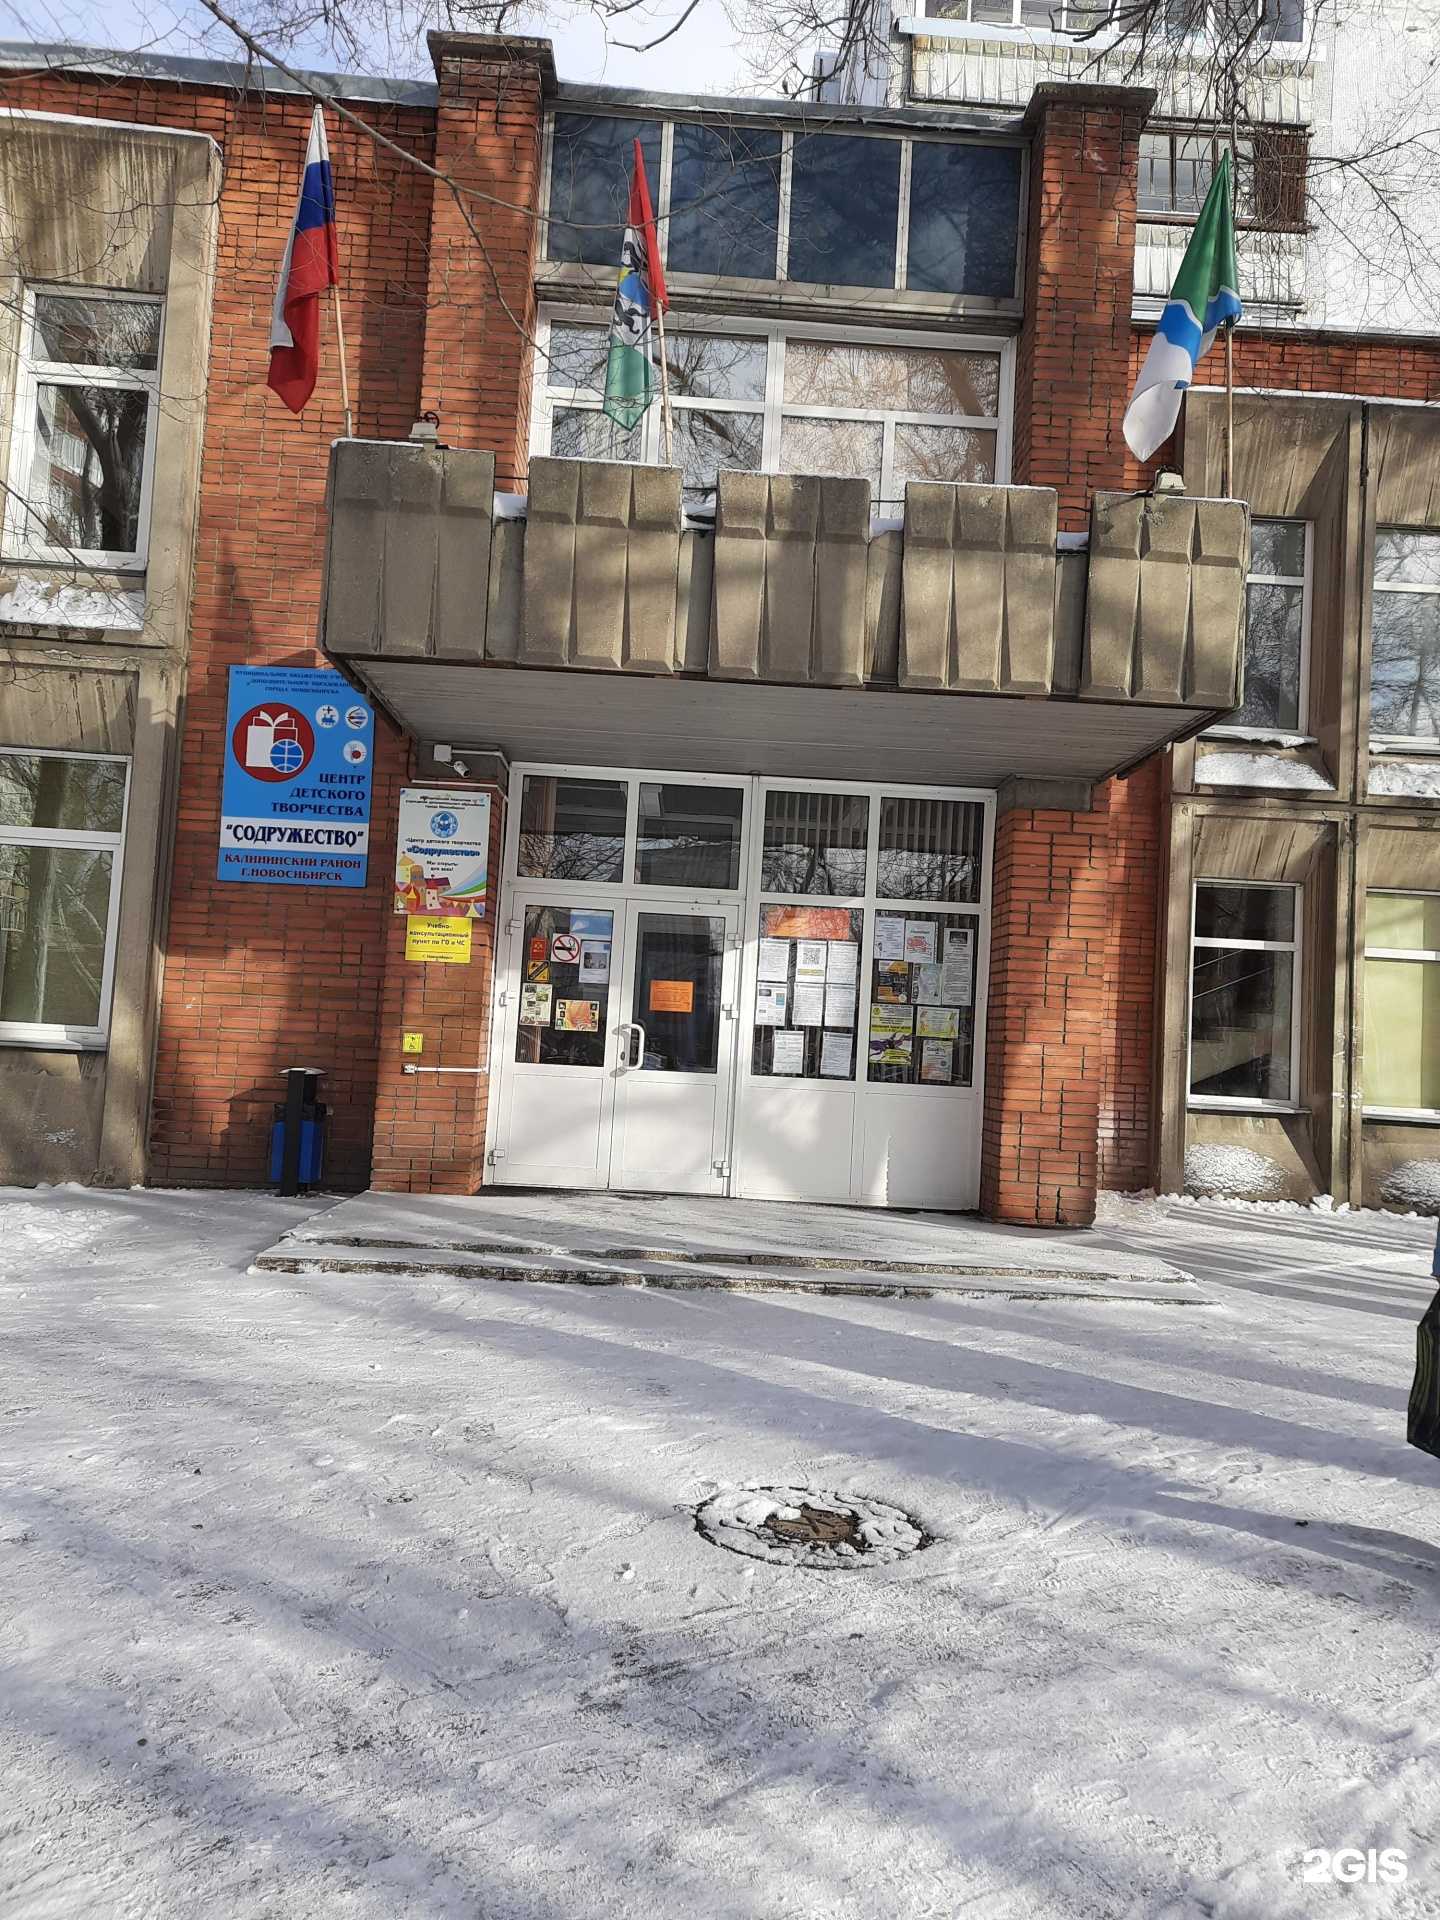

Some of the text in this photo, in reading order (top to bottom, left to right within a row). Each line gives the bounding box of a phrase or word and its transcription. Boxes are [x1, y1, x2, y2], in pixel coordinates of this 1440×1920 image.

[319, 773, 366, 784] ЦЕНТР
[289, 787, 366, 800] ДЕТСКОГО
[271, 802, 364, 816] ТВОРЧЕСТВА
